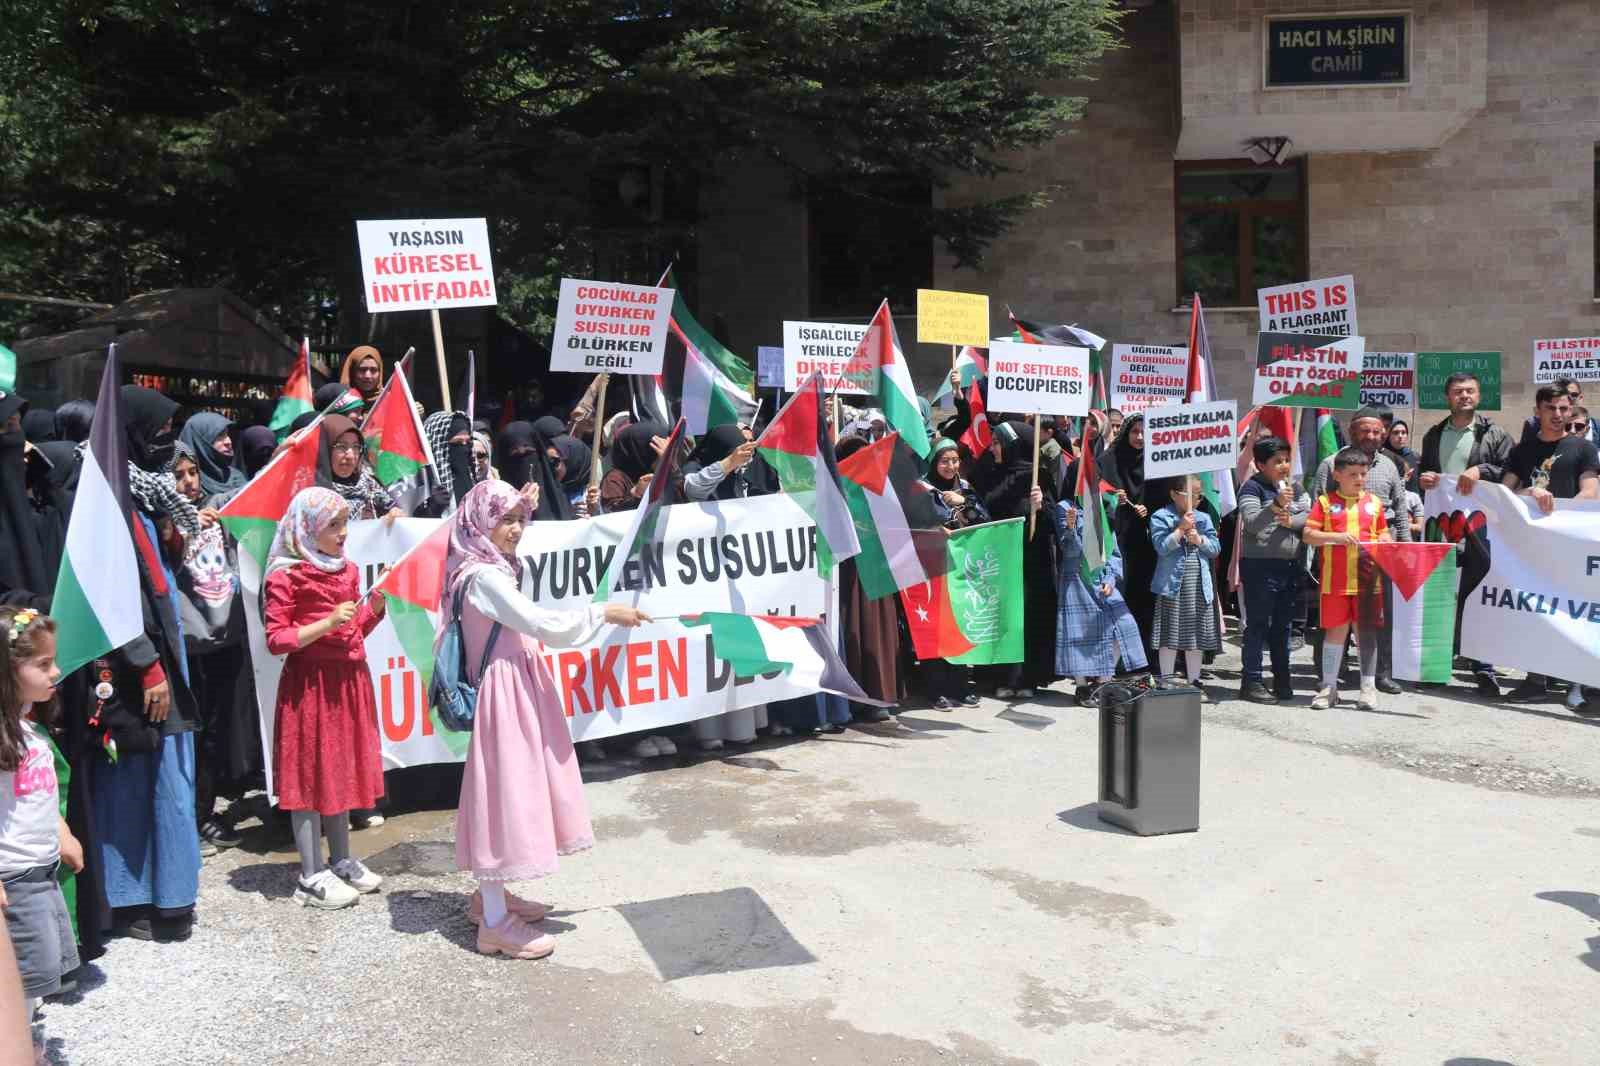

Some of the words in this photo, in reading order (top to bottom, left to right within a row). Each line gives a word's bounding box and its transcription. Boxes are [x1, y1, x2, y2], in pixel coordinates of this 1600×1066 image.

[1279, 31, 1321, 48] HACI
[1311, 51, 1363, 73] CAMİİ
[388, 230, 464, 248] YAŞASIN
[374, 252, 483, 275] KÜRESEL
[372, 280, 491, 304] İNTİFADA!
[1264, 289, 1317, 315] THIS
[1323, 284, 1347, 307] IS
[575, 303, 656, 321] UYURKEN
[1268, 319, 1278, 331] A
[1281, 309, 1348, 330] FLAGRANT
[574, 320, 652, 337] SUSULUR
[567, 335, 653, 353] ÖLÜRKEN
[584, 353, 633, 368] DEĞİL!
[995, 361, 1020, 373] NOT
[1258, 366, 1304, 379] ELBET
[1307, 365, 1358, 381] ÖZGÜR
[995, 376, 1083, 395] OCCUPIERS!
[1269, 380, 1345, 397] OLACAK
[1149, 412, 1191, 429] SESSİZ
[1193, 410, 1234, 425] KALMA
[1151, 425, 1232, 446] SOYKIRIMA
[1151, 447, 1192, 462] ORTAK
[1194, 443, 1232, 457] OLMA!
[1481, 585, 1560, 615] HAKLI
